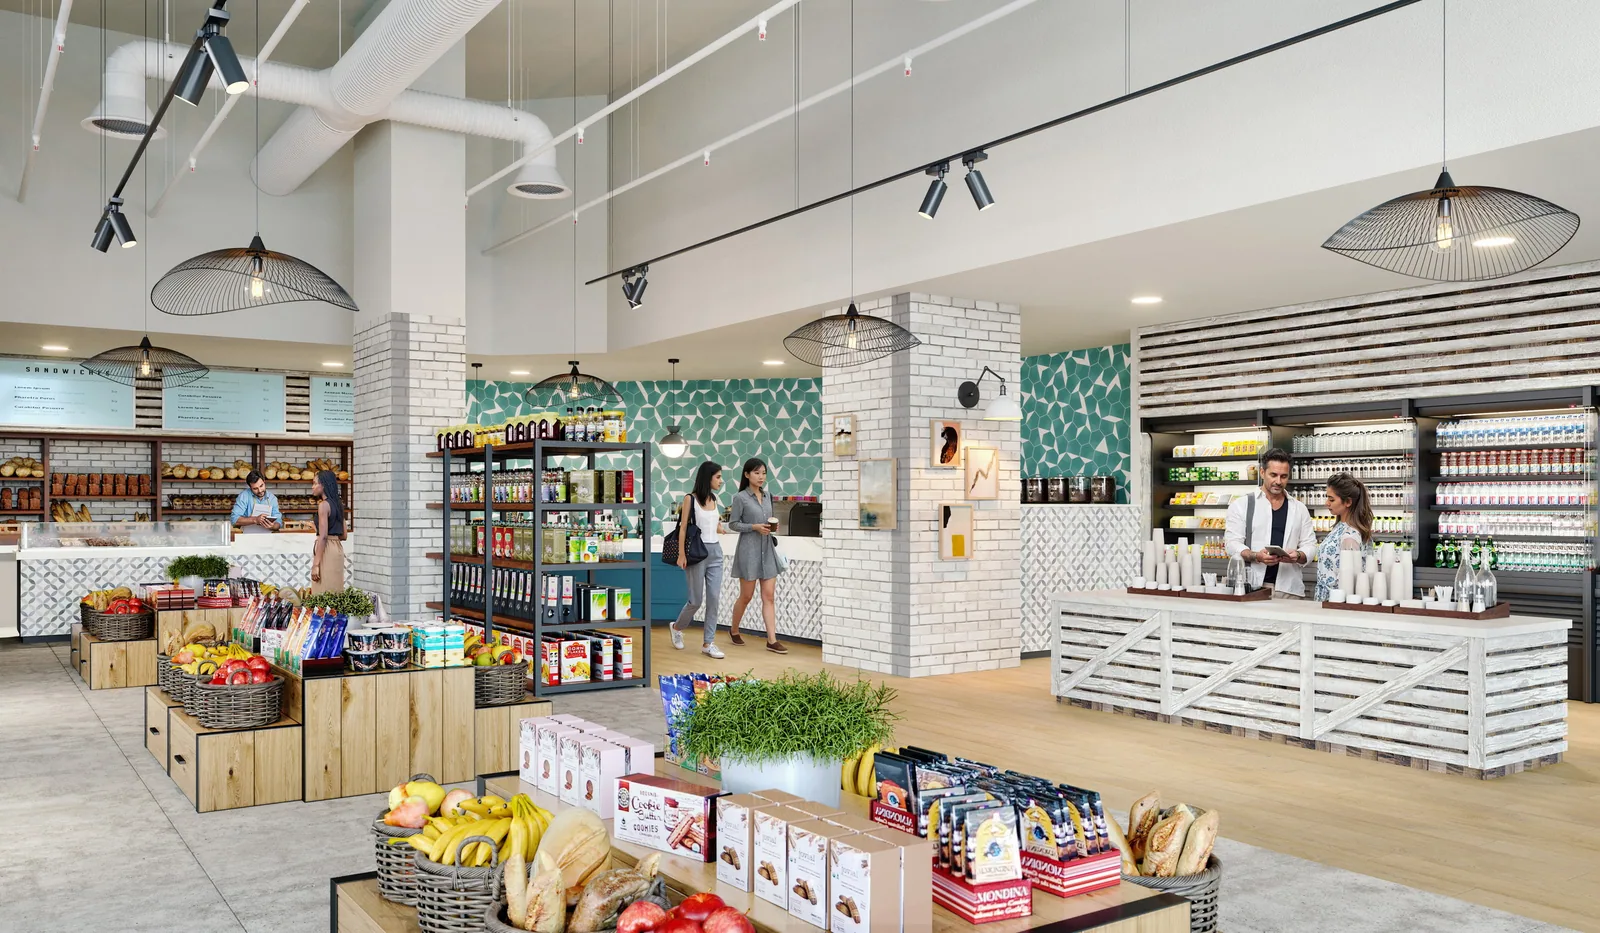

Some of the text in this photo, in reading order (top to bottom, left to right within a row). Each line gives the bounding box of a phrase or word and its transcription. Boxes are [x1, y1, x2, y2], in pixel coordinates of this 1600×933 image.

[631, 795, 661, 812] Cookie
[633, 809, 662, 821] Butter
[633, 823, 659, 833] COOKIES
